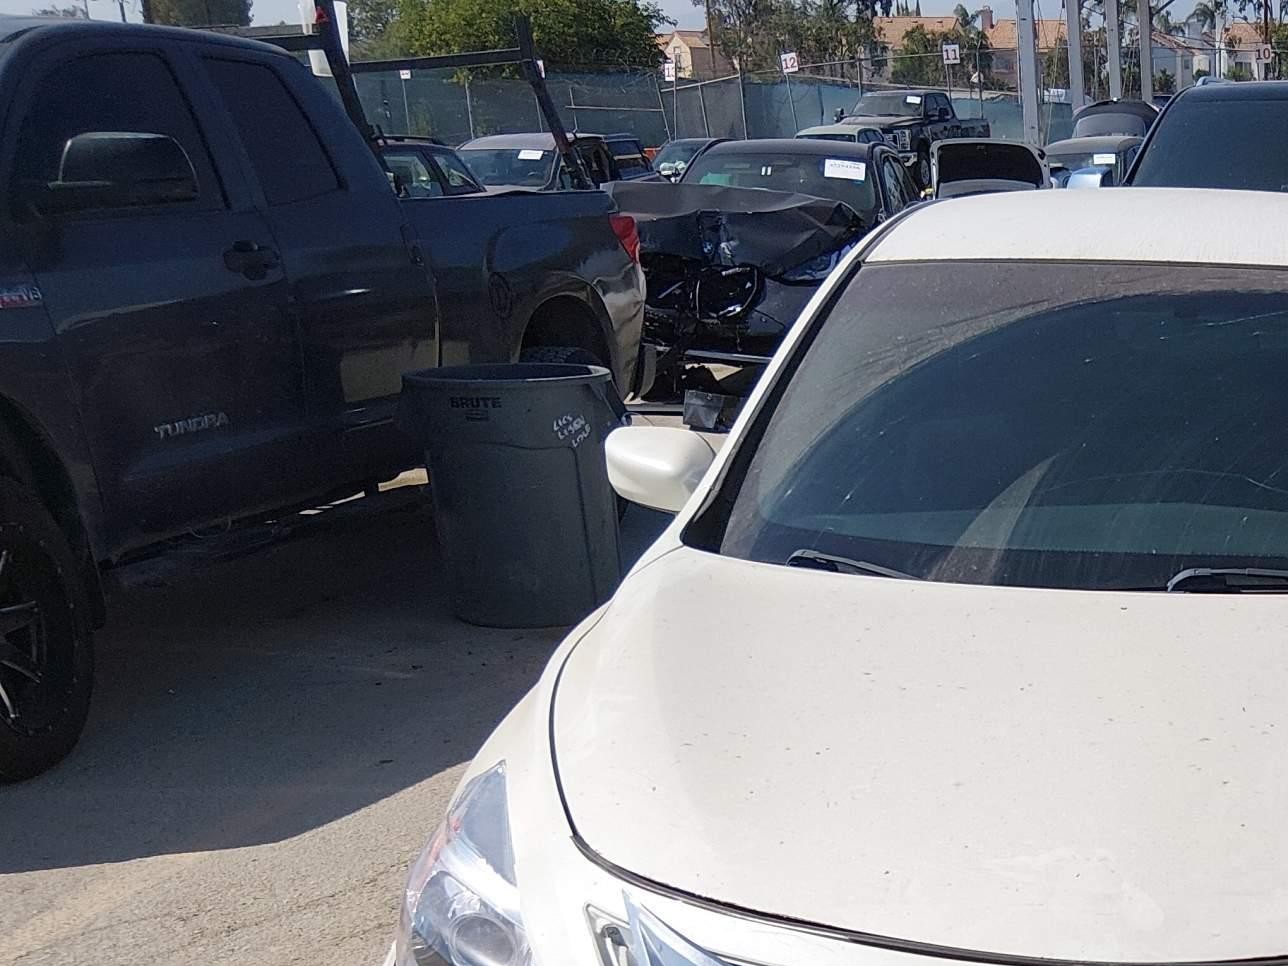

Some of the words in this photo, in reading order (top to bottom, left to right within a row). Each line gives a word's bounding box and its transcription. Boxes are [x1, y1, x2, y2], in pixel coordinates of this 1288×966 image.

[943, 48, 959, 60] 11
[1255, 47, 1271, 60] 10
[783, 56, 797, 70] 12
[449, 396, 502, 409] BRUTE
[153, 411, 230, 441] TUNDRA
